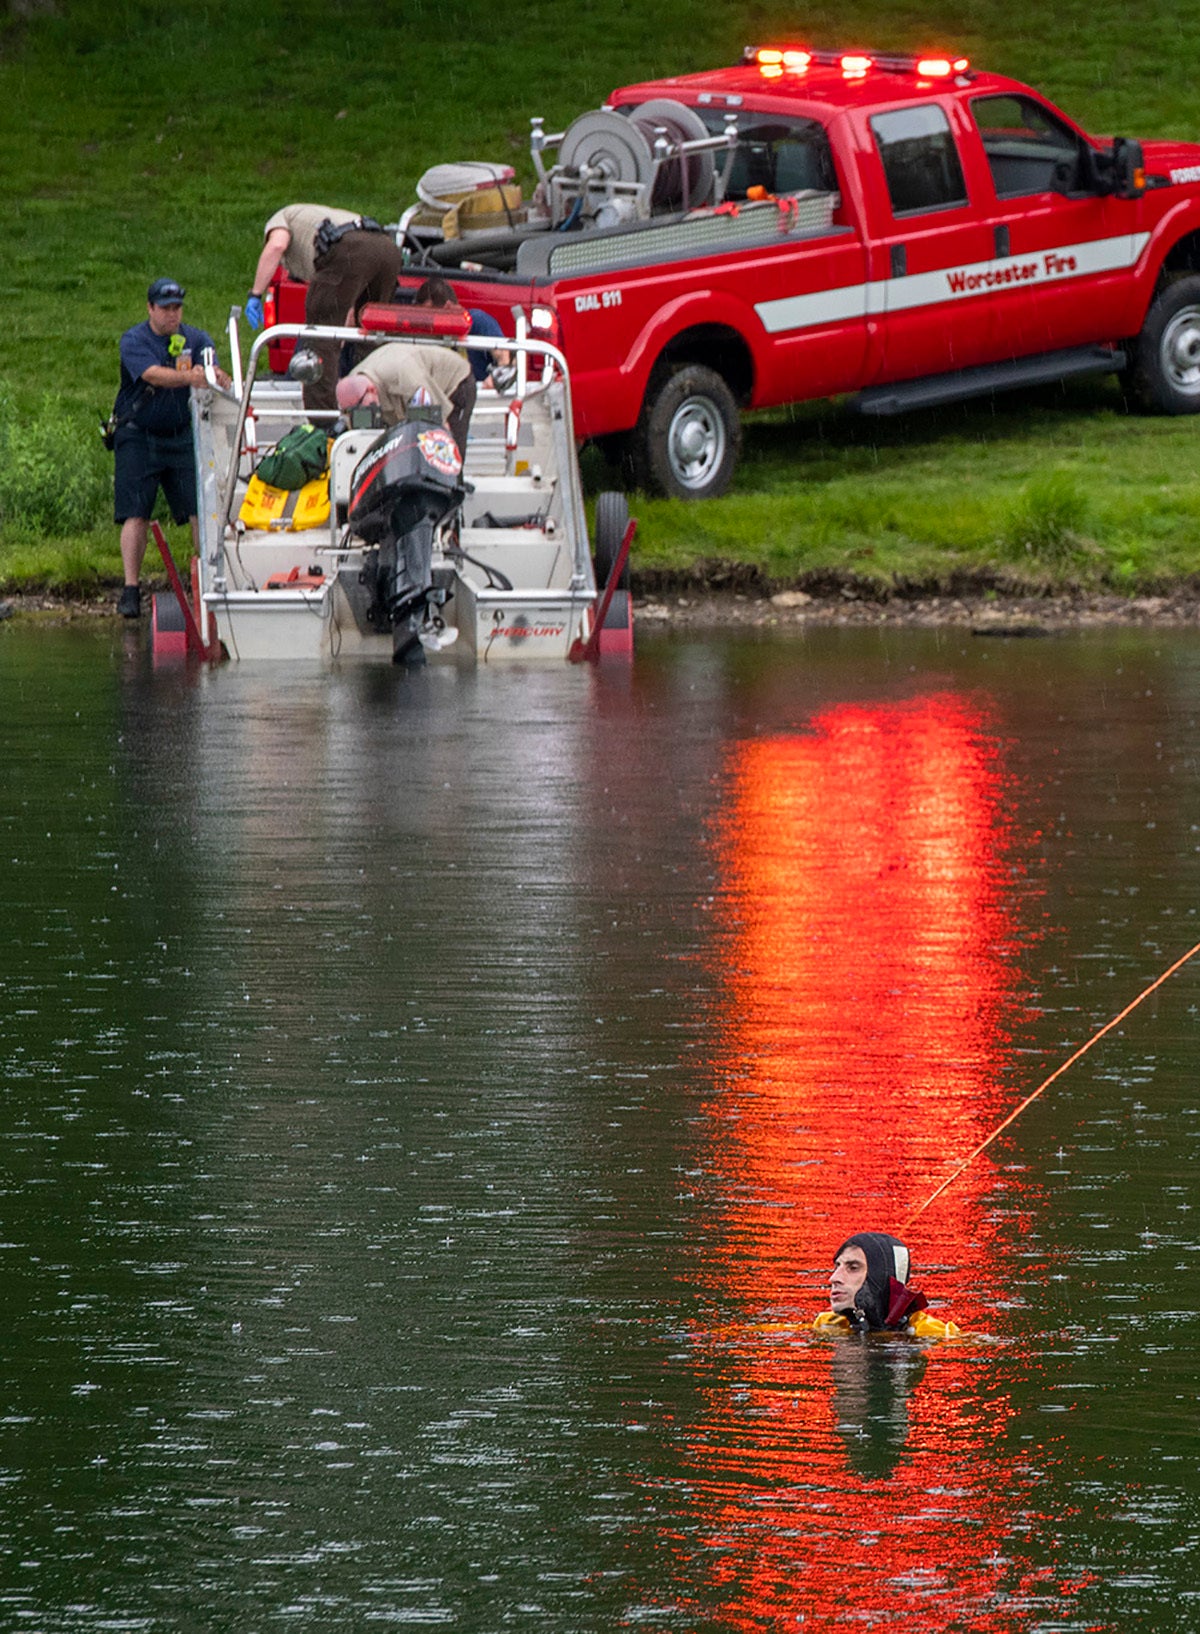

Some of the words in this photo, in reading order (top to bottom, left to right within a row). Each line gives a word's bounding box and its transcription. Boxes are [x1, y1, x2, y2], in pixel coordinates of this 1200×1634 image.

[946, 263, 1037, 293] Worcester
[1043, 253, 1077, 275] Fire
[575, 293, 602, 313] DIAL
[602, 289, 622, 308] 911
[490, 627, 563, 637] MERCURY
